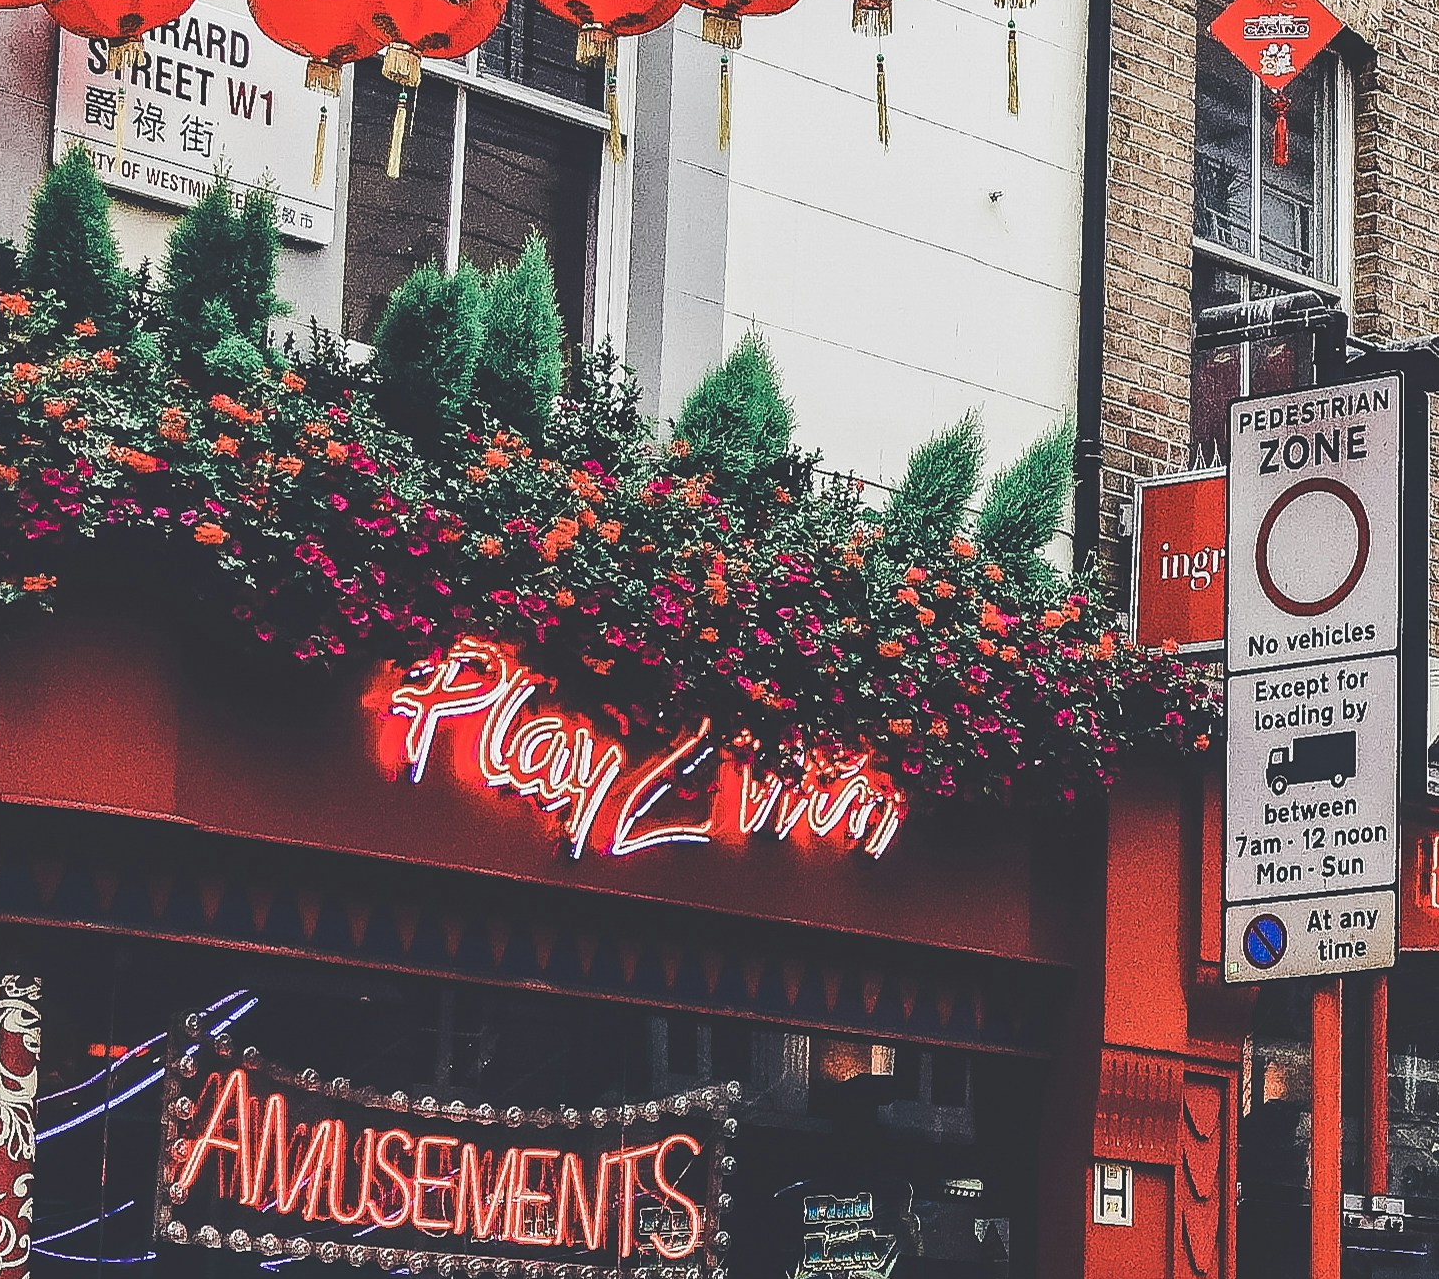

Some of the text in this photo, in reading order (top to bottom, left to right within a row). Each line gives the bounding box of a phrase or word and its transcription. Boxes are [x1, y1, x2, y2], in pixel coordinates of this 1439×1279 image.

[150, 17, 250, 69] RARD
[1243, 23, 1310, 37] CASINO
[227, 77, 273, 126] W1
[84, 85, 215, 158] 爵祿街
[122, 160, 141, 180] OF
[1238, 389, 1391, 435] PEDESTRIAN
[1258, 425, 1369, 474] ZONE
[1248, 621, 1376, 657] No vehicles
[1254, 668, 1369, 703] Except for
[1254, 700, 1369, 731] loading by
[390, 636, 623, 860] Play
[1264, 796, 1358, 826] between
[1235, 832, 1282, 858] 7am
[1302, 827, 1327, 851] 12
[1333, 823, 1388, 845] noon
[1256, 859, 1300, 886] Mon
[1321, 854, 1365, 880] Sun
[1306, 907, 1379, 933] At any
[1317, 935, 1368, 960] time
[177, 1068, 705, 1261] AMUSEMENTS
